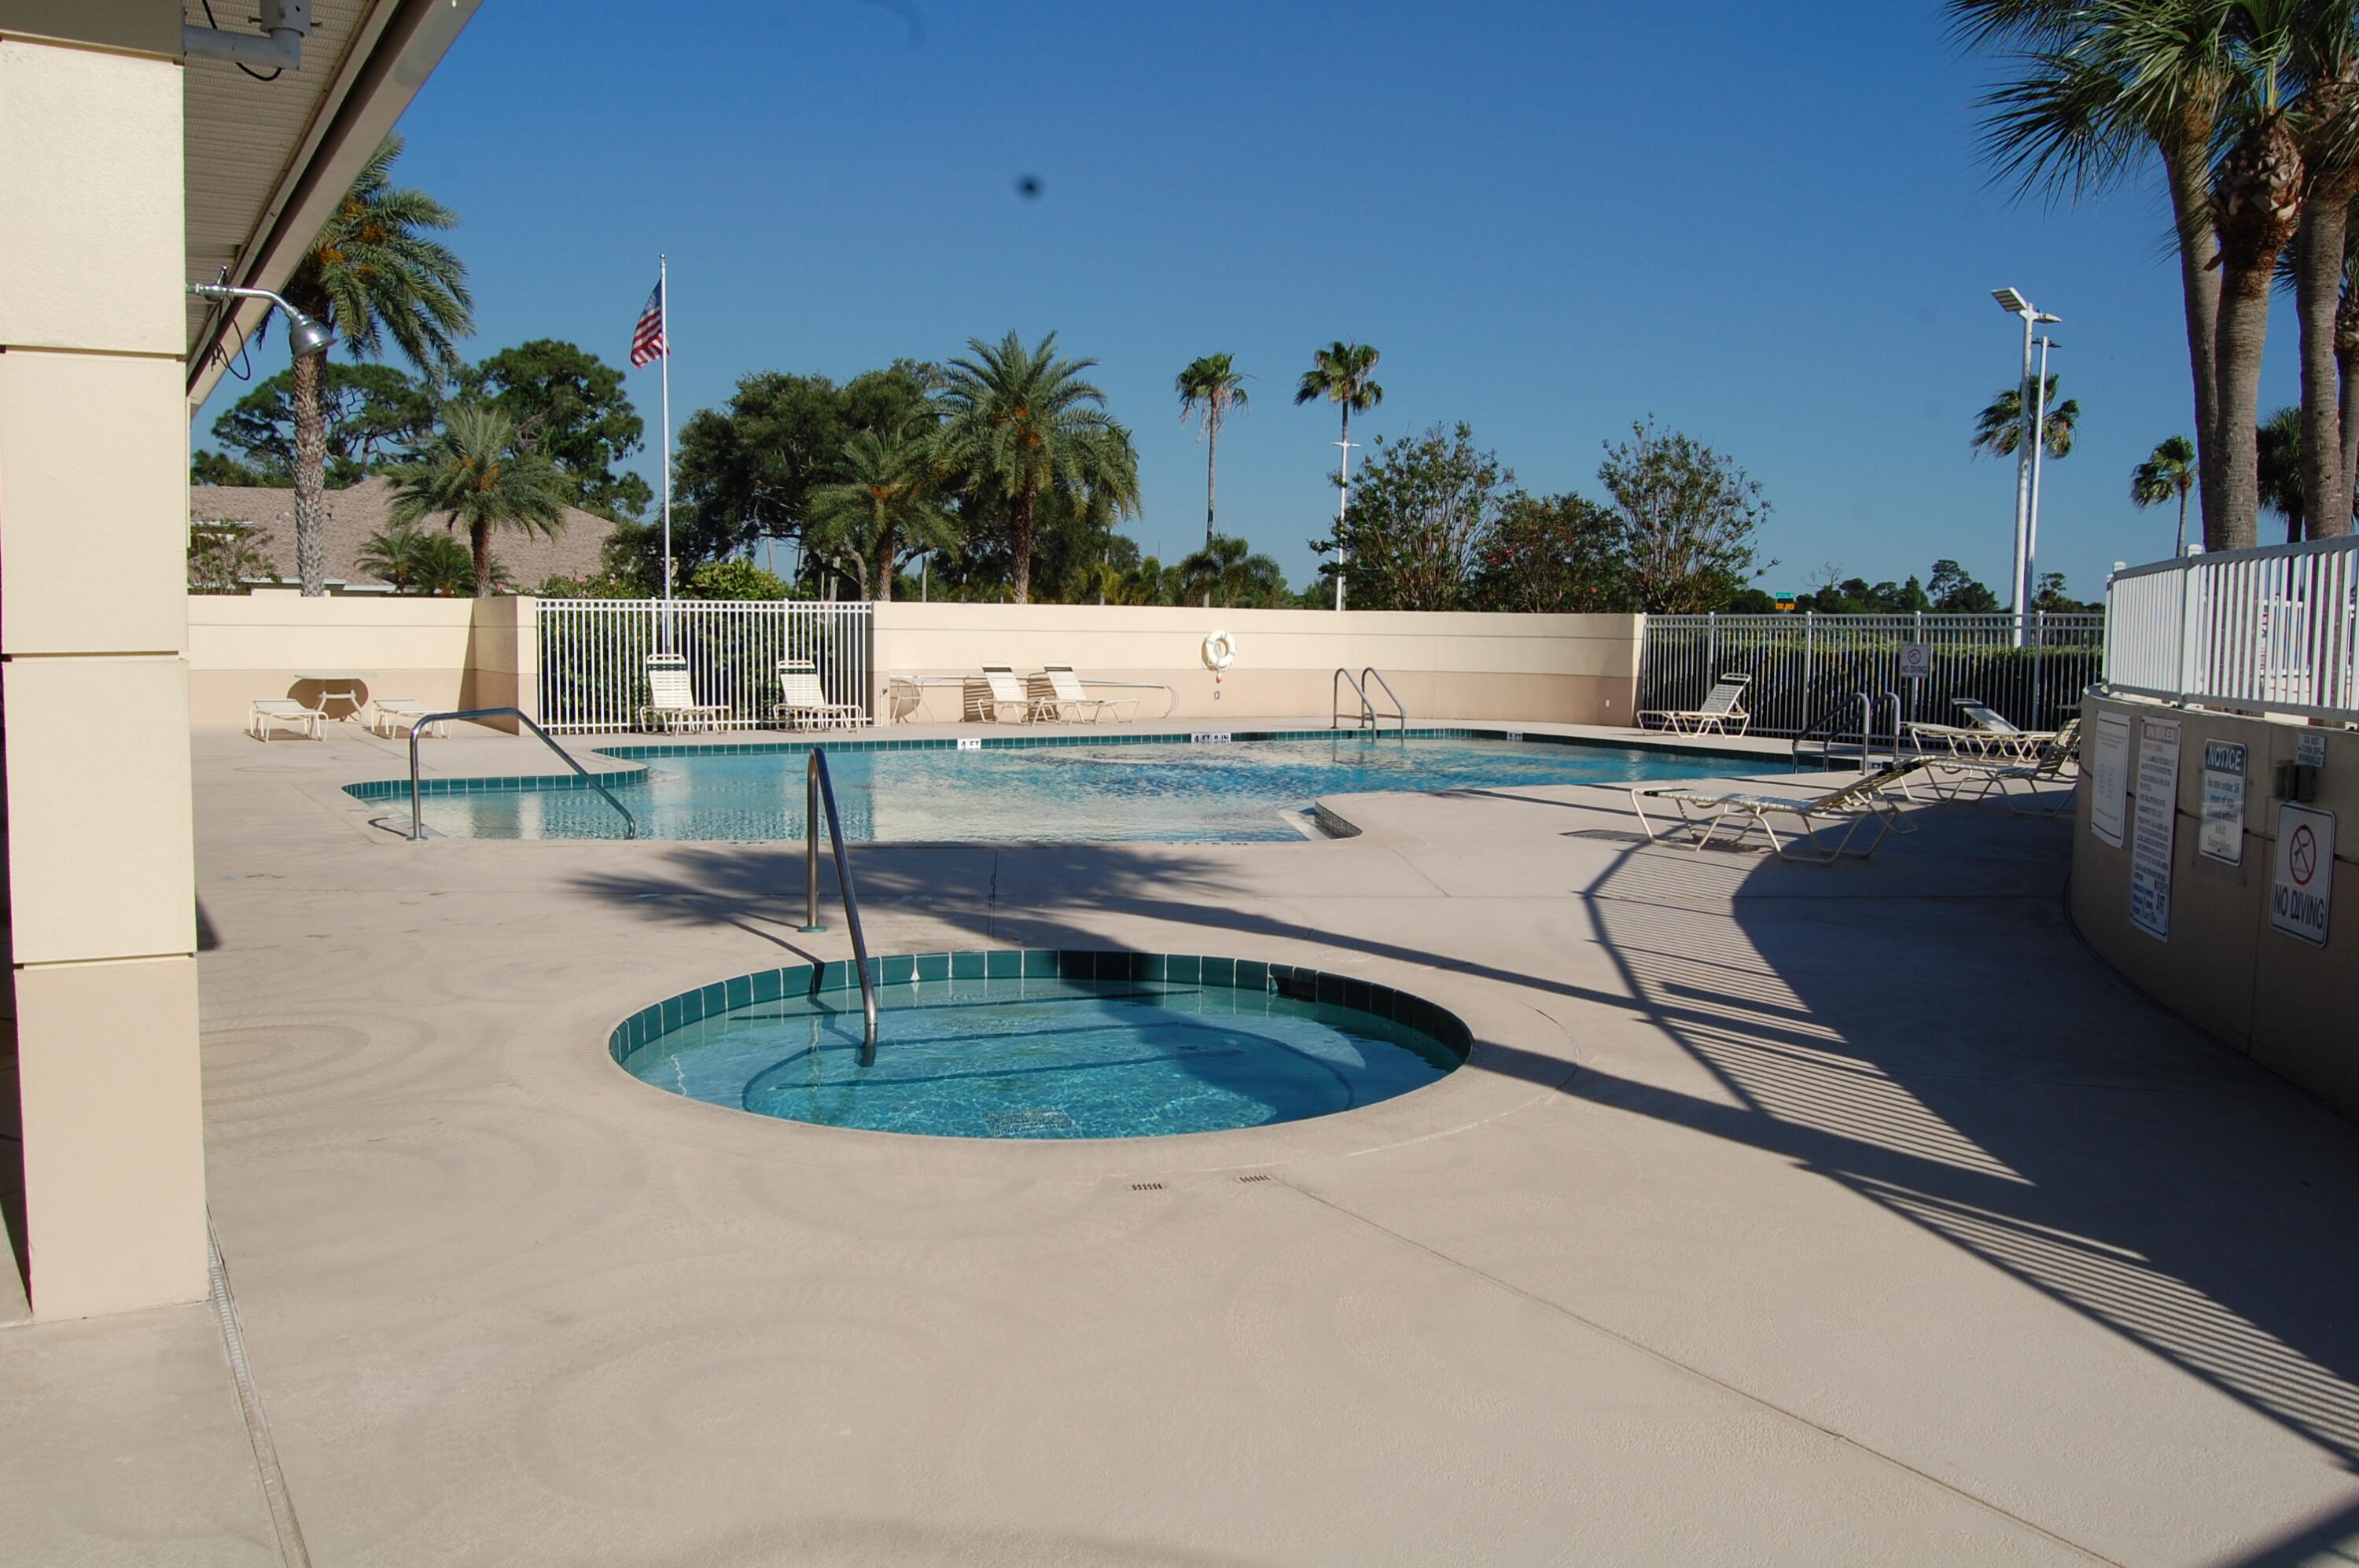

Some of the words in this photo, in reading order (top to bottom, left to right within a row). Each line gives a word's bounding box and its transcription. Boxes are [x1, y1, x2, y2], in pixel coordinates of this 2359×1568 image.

[1910, 665, 1927, 674] DIVING
[2207, 745, 2242, 771] NOTICE
[2273, 884, 2288, 916] NO
[2290, 889, 2324, 929] DIVING
